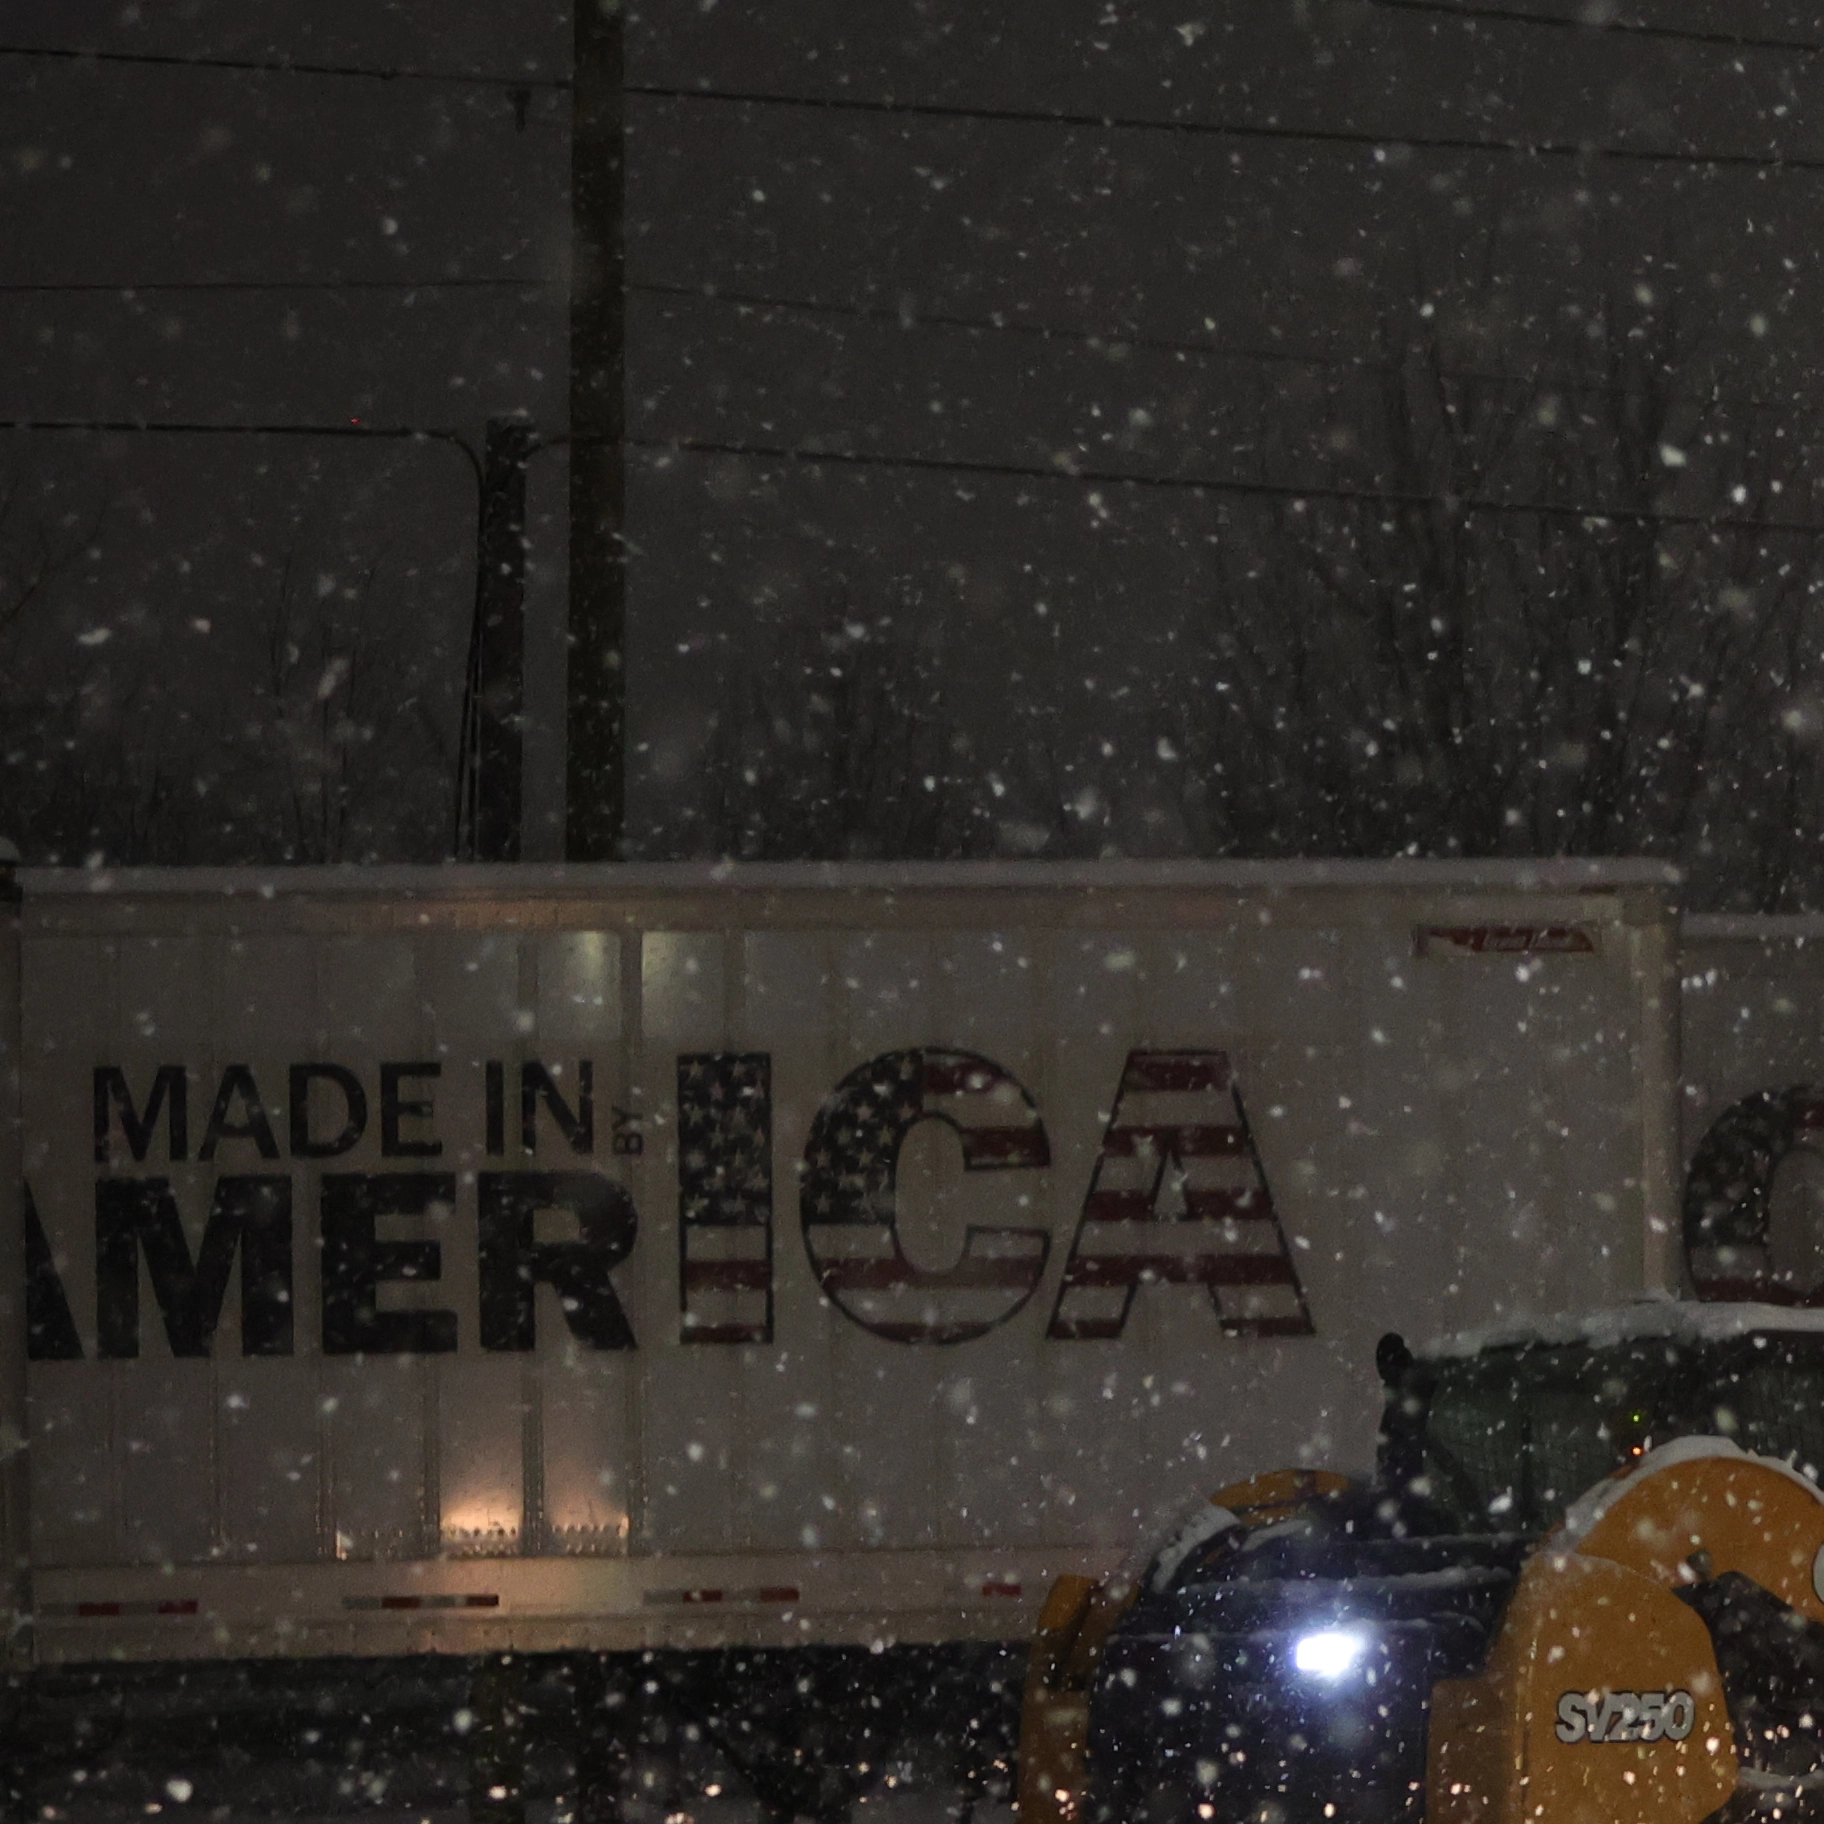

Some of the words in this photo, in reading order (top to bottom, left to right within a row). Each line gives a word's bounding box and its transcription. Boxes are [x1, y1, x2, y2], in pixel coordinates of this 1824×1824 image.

[93, 1062, 442, 1161] MADE
[486, 1059, 593, 1156] IN
[611, 1104, 643, 1156] BY
[1554, 1688, 1695, 1743] SV250
